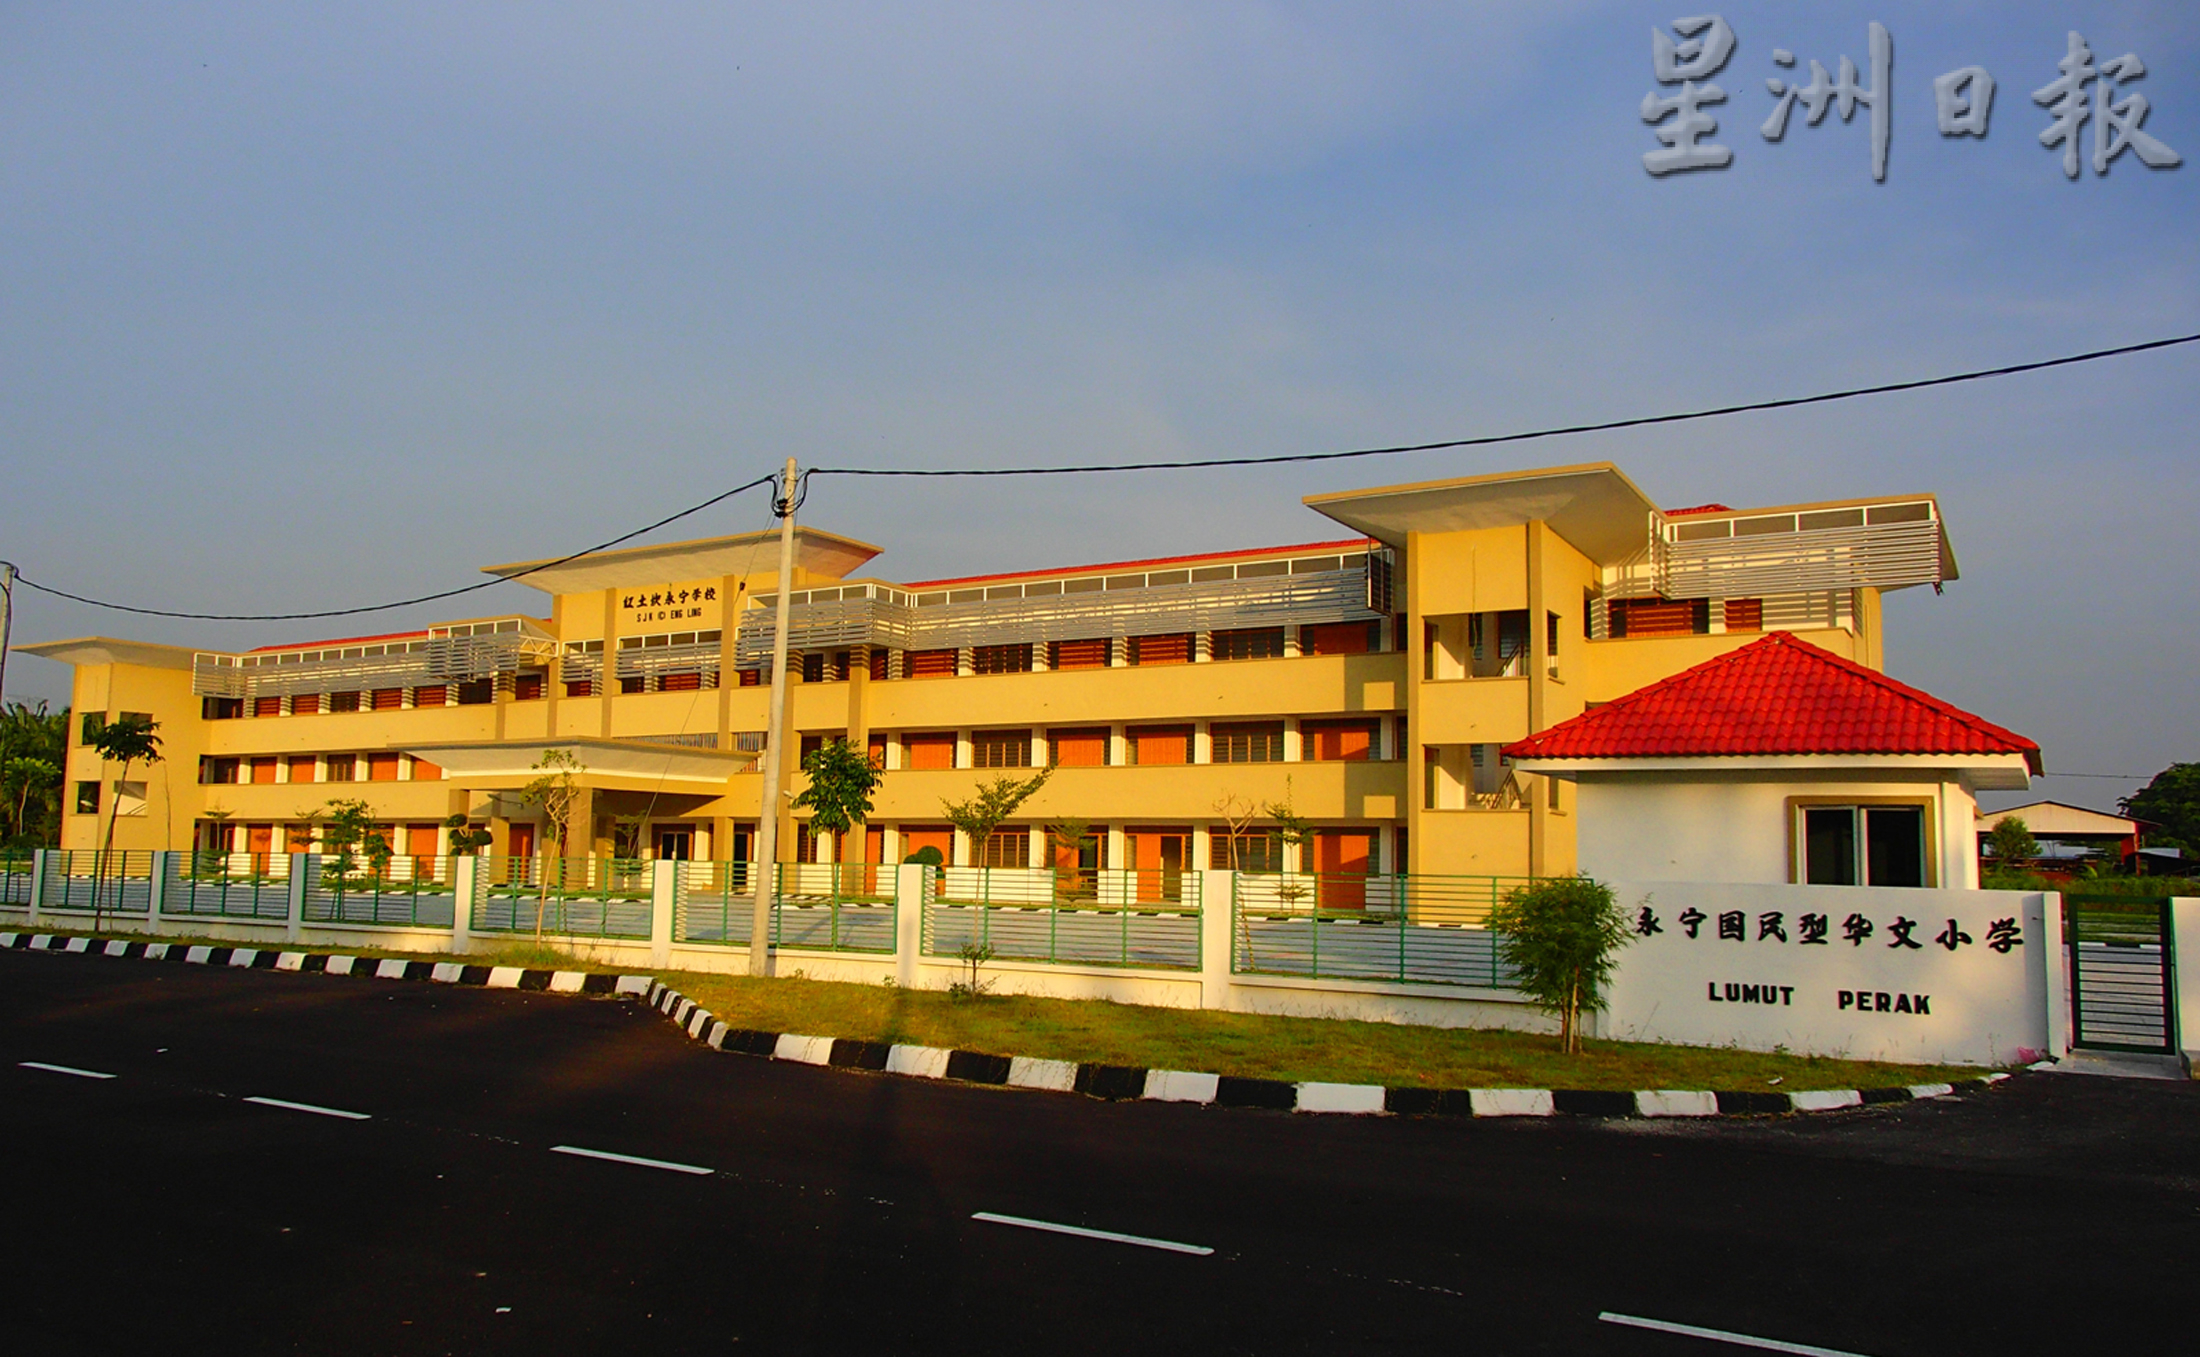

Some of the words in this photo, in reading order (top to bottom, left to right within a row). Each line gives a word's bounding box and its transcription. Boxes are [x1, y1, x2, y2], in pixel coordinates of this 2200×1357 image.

[670, 609, 683, 619] ENG
[687, 607, 702, 618] LING
[1636, 906, 2024, 954] 永宁国民型华文小学
[1708, 981, 1795, 1006] LUMUT
[1837, 990, 1931, 1015] PERAK
